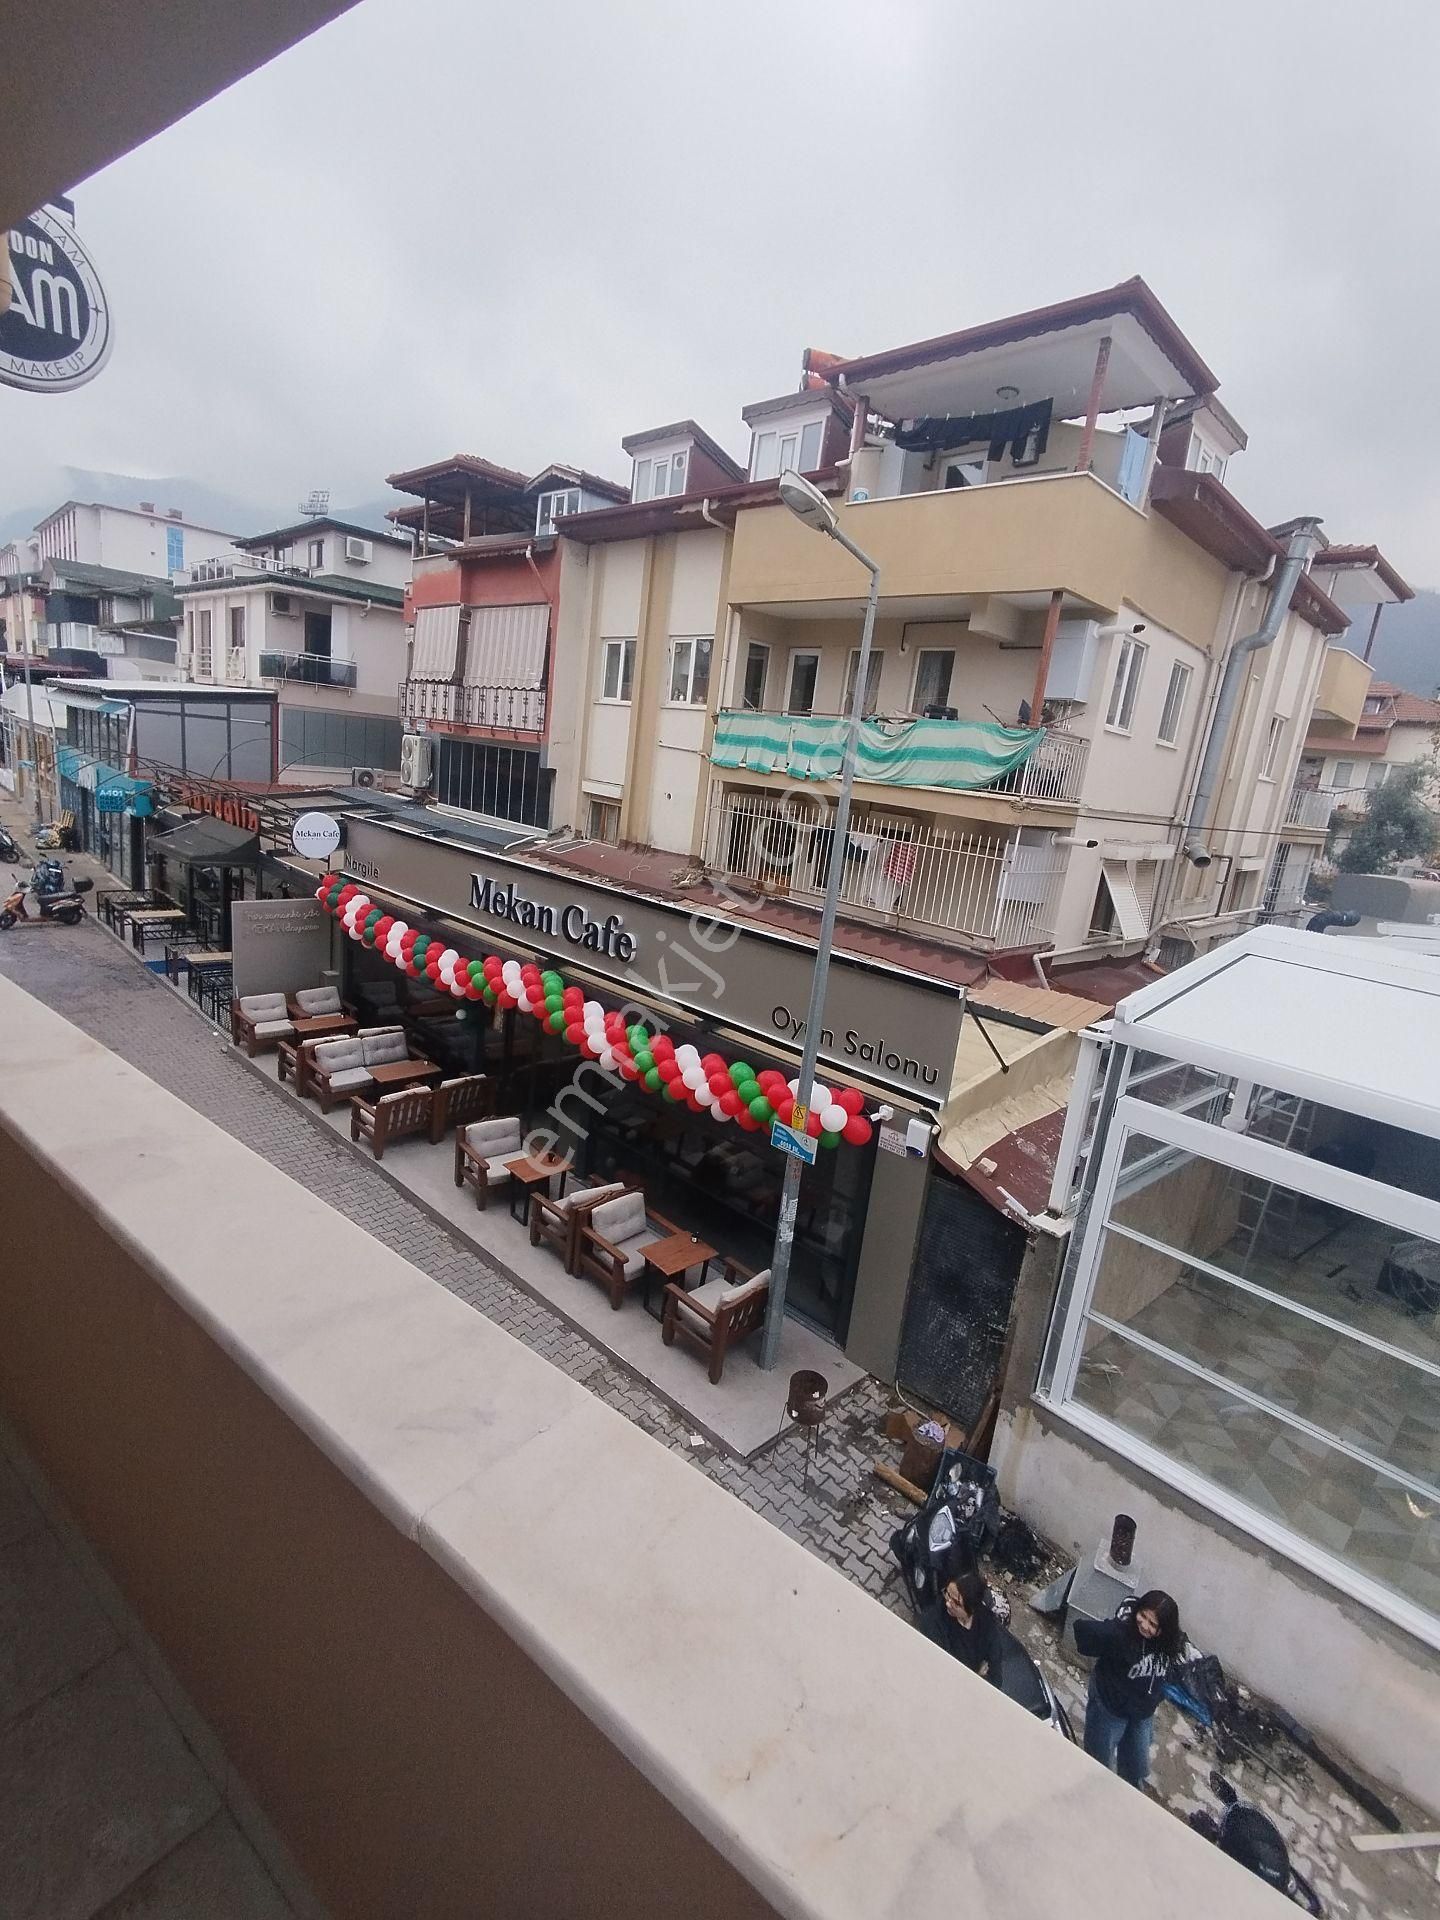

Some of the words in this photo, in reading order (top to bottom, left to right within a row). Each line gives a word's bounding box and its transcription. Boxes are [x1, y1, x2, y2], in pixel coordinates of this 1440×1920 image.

[295, 830, 321, 838] Mekan
[322, 830, 340, 838] Cafe
[345, 852, 379, 878] Nargile
[468, 873, 558, 937] Mekan
[562, 904, 637, 963] Cafe
[771, 1005, 834, 1047] Oyn
[844, 1029, 939, 1085] Salonu
